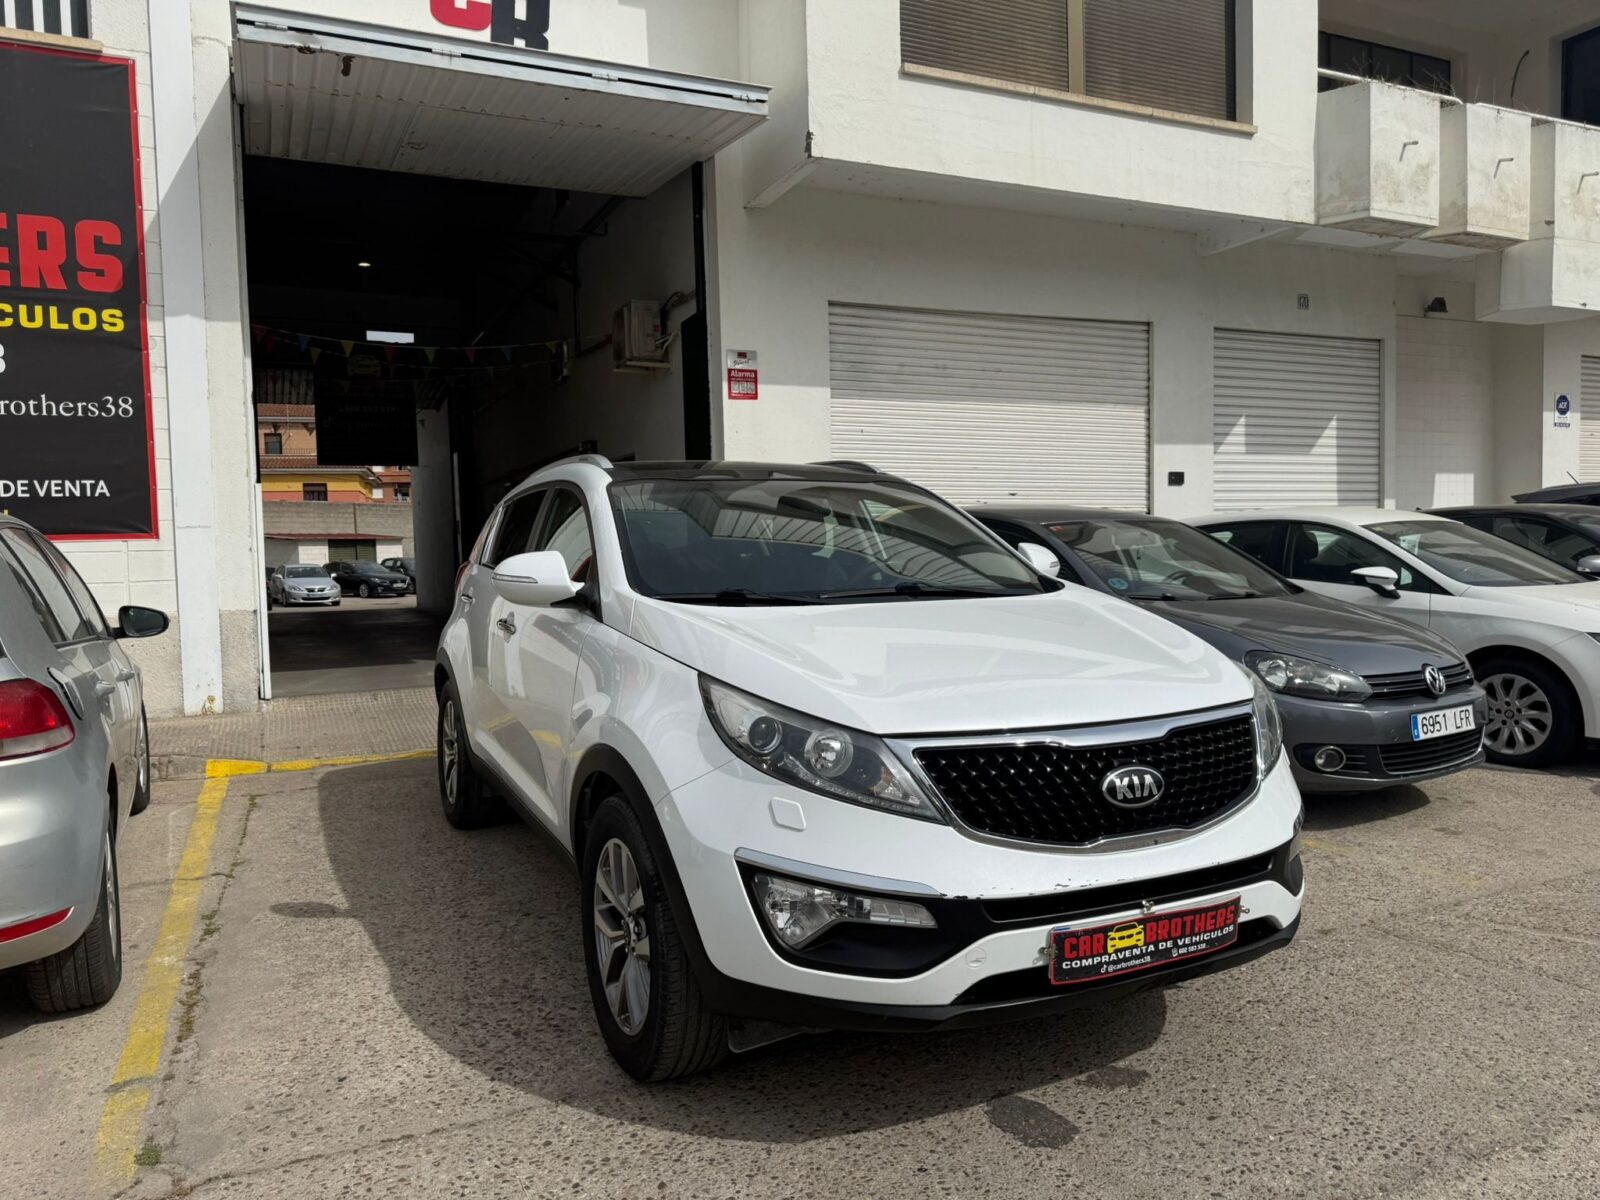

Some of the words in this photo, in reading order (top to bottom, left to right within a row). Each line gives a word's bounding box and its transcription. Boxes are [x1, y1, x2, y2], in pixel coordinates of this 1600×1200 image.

[0, 213, 123, 293] RS
[0, 303, 125, 332] CULOS
[730, 370, 755, 378] Alarma
[0, 394, 134, 418] rothers38
[0, 480, 30, 497] DE
[33, 479, 110, 497] VENTA
[1421, 713, 1448, 735] 6951
[1454, 709, 1471, 729] LFR
[1112, 774, 1158, 800] KIA
[1064, 933, 1104, 959] CAR
[1146, 905, 1235, 943] BROTHERS
[1062, 944, 1155, 969] COMPRAVENTA
[1159, 940, 1174, 950] DE
